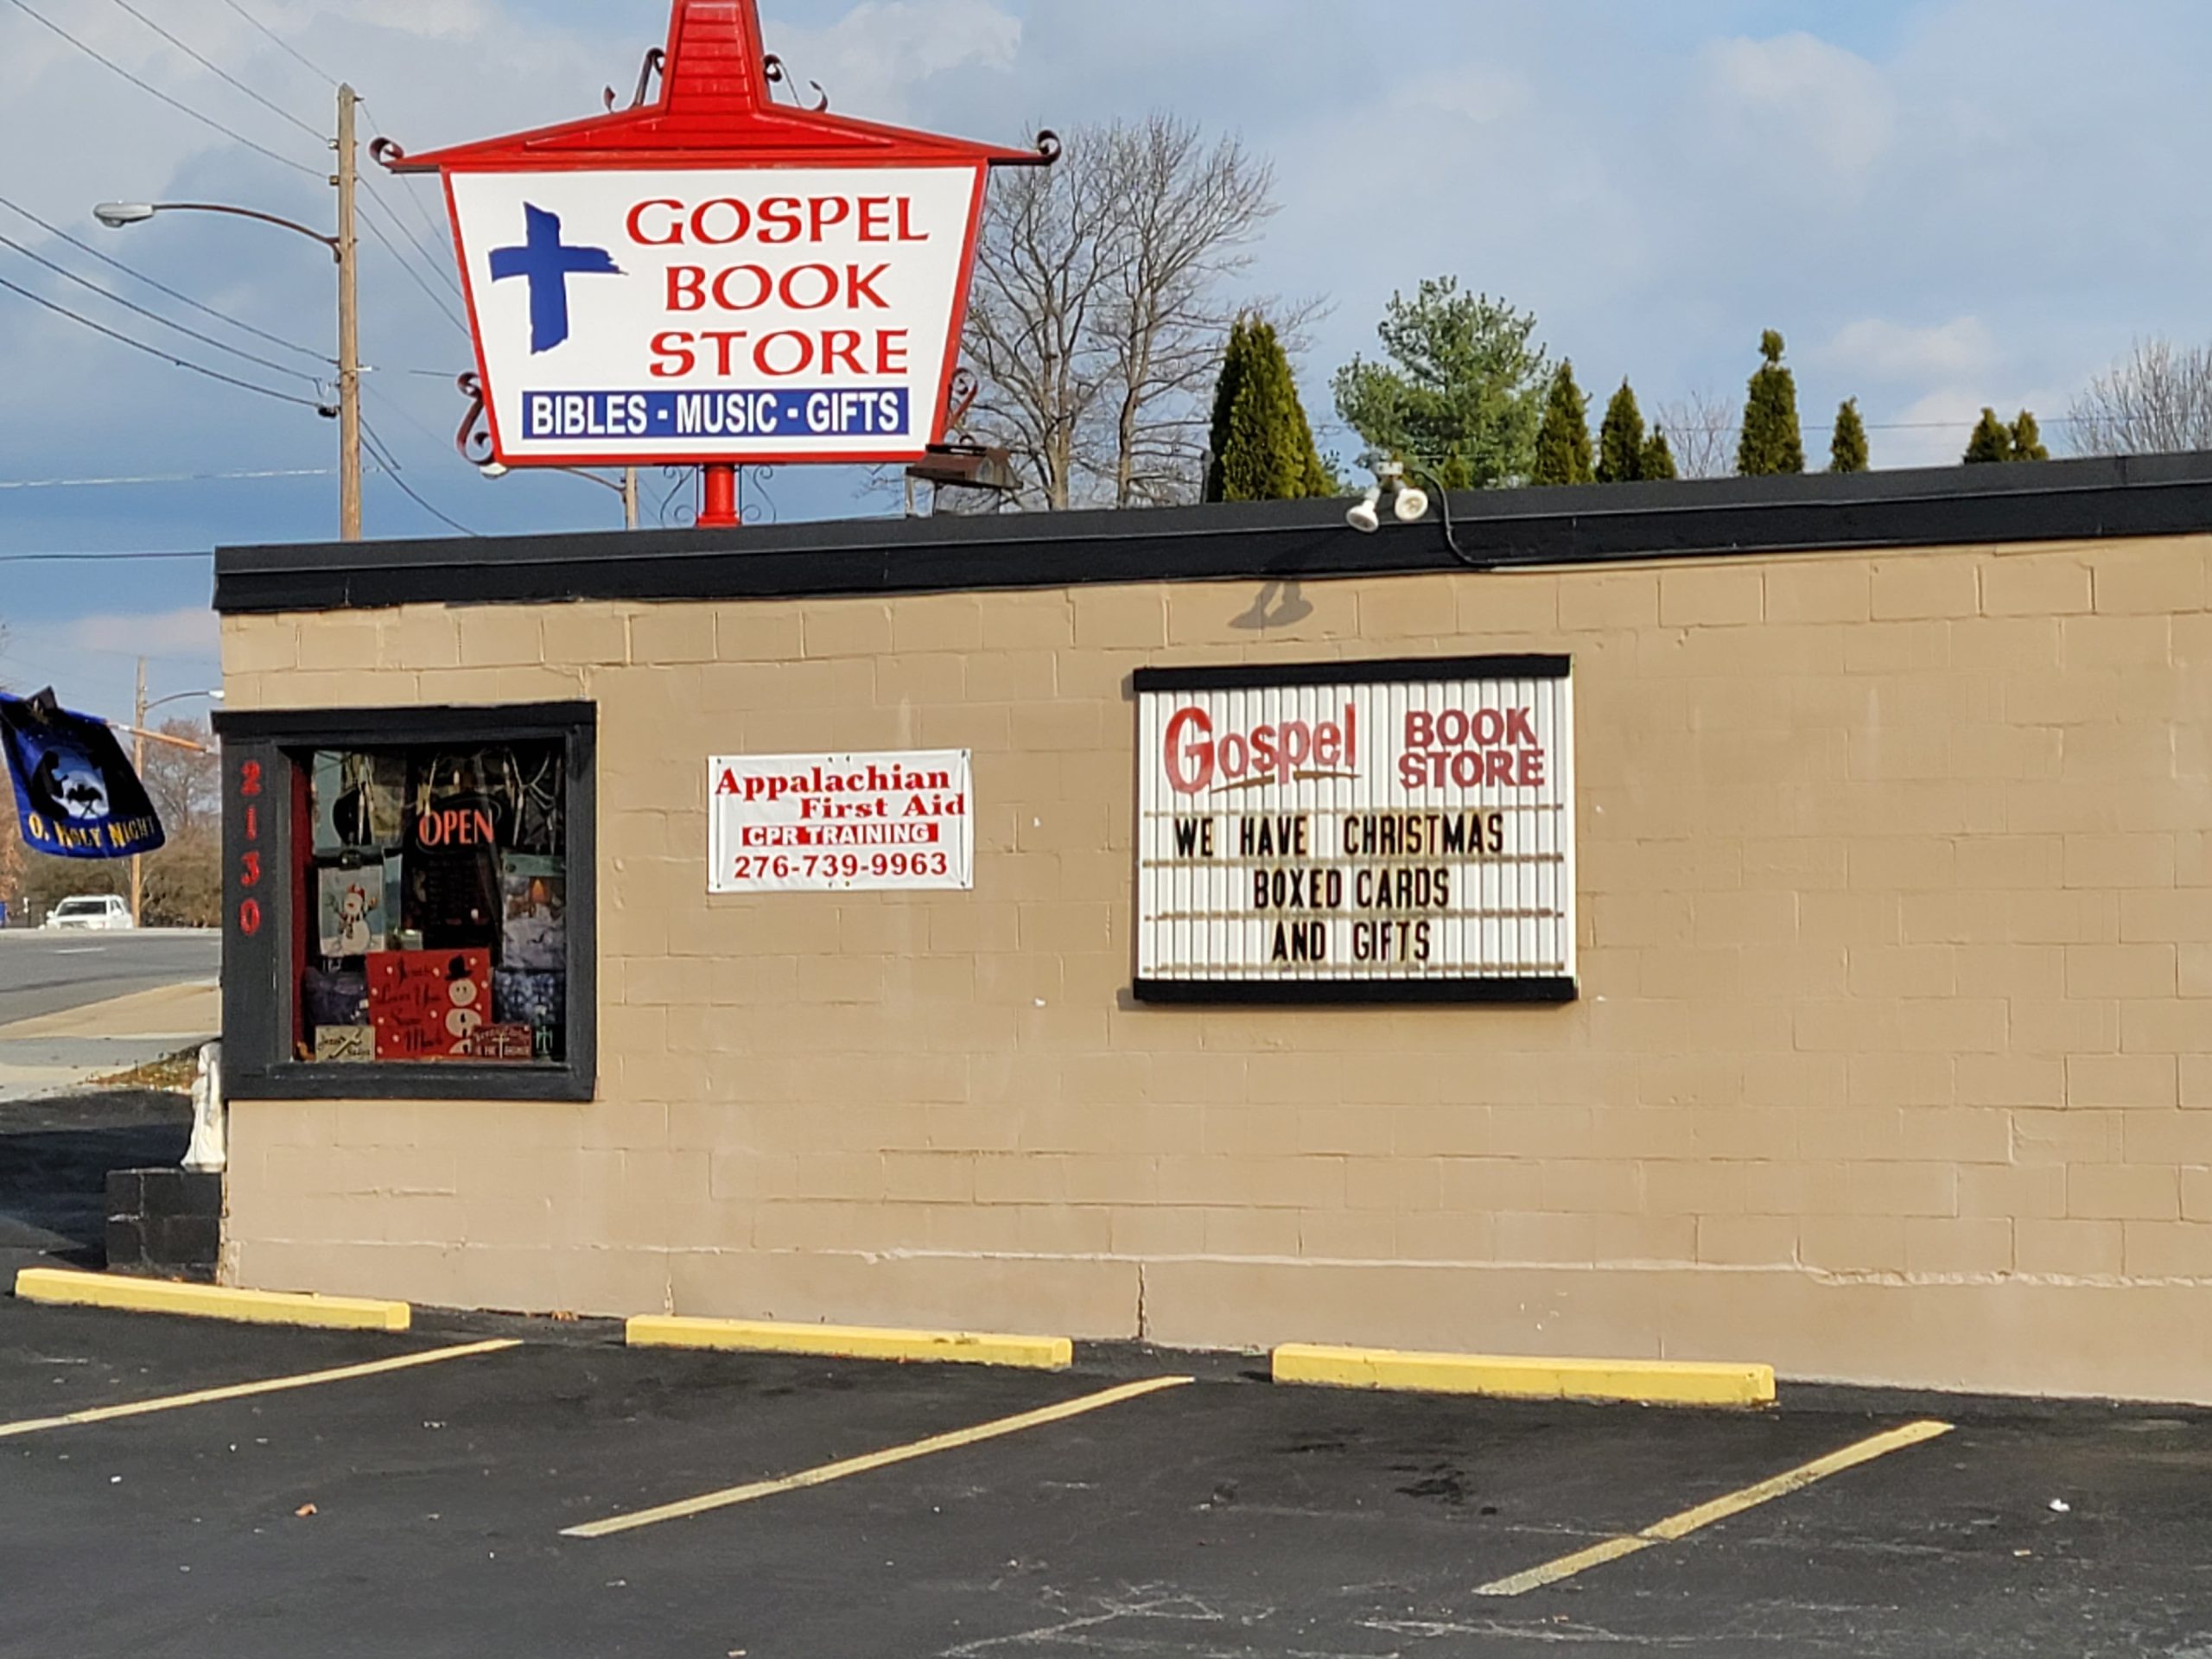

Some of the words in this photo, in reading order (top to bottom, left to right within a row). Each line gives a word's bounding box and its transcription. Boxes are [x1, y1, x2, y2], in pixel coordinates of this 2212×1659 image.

[626, 195, 930, 245] GOSPEL
[664, 263, 891, 311] BOOK
[649, 327, 908, 377] STORE
[531, 395, 648, 435] BIBLES
[676, 397, 778, 433] MUSIC
[805, 393, 899, 432] GIFTS
[1404, 706, 1537, 749] BOOK
[1163, 702, 1356, 796] Gospel
[1397, 747, 1546, 791] STORE
[715, 763, 951, 802] Appalachian
[798, 796, 889, 820] First
[901, 792, 966, 817] Aid
[418, 808, 495, 847] OPEN
[748, 827, 800, 846] CPR
[804, 823, 930, 845] TRAINING
[1175, 817, 1214, 858] WE
[1240, 816, 1307, 857] HAVE
[1344, 813, 1504, 855] CHRISTMAS
[734, 851, 948, 880] 276-739-9963
[1254, 869, 1342, 910] BOXED
[1356, 868, 1450, 908] CARDS
[1272, 922, 1326, 962] AND
[1353, 921, 1431, 962] GIFTS
